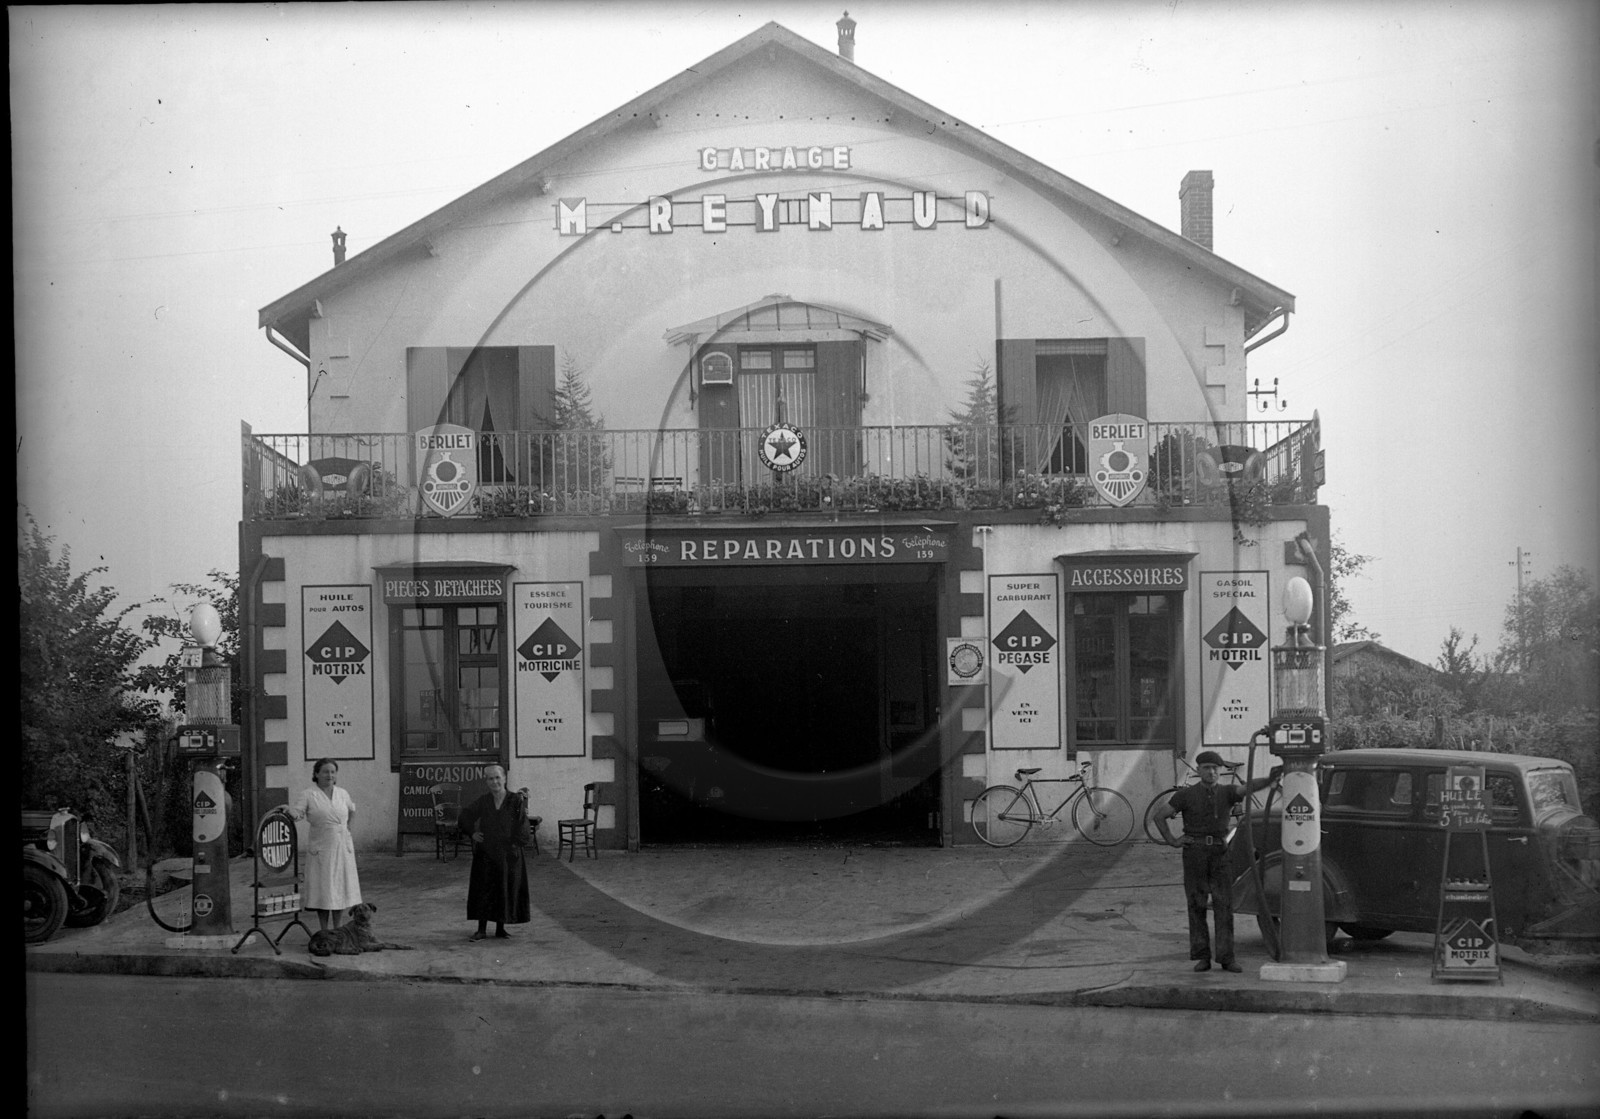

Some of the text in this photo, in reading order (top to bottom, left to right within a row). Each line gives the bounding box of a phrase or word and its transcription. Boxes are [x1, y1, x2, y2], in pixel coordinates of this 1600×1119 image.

[702, 147, 849, 170] GARAGE
[649, 191, 990, 235] REYNAUD
[761, 423, 803, 439] TEXACO
[1092, 424, 1145, 439] BERLIET
[420, 434, 472, 450] BERLIET
[759, 448, 806, 472] HUILE POUR AUTOS
[680, 537, 896, 561] REPARATIONS
[917, 550, 934, 559] 139
[638, 553, 657, 563] 139
[1071, 567, 1184, 586] ACCESSOIRES
[1216, 579, 1253, 587] GASOIL
[386, 579, 502, 597] PIECES DETACHEES
[997, 594, 1051, 602] CARBURANT
[1007, 635, 1042, 648] CIP
[1218, 632, 1253, 645] CIP
[320, 646, 356, 659] CIP
[532, 643, 567, 656] CIP
[1209, 649, 1262, 661] MOTRIL
[998, 652, 1051, 664] PEGASE
[312, 663, 366, 676] MOTRIX
[518, 660, 582, 672] MOTRICINE
[416, 766, 486, 783] OCCASION
[1440, 790, 1482, 802] HUILE
[403, 808, 444, 817] VOITURS
[1284, 814, 1316, 822] MOTRICINE
[262, 820, 290, 845] HUILES
[262, 844, 292, 868] RENAULT
[1457, 937, 1484, 948] CIP
[1450, 950, 1490, 959] MOTRIX
